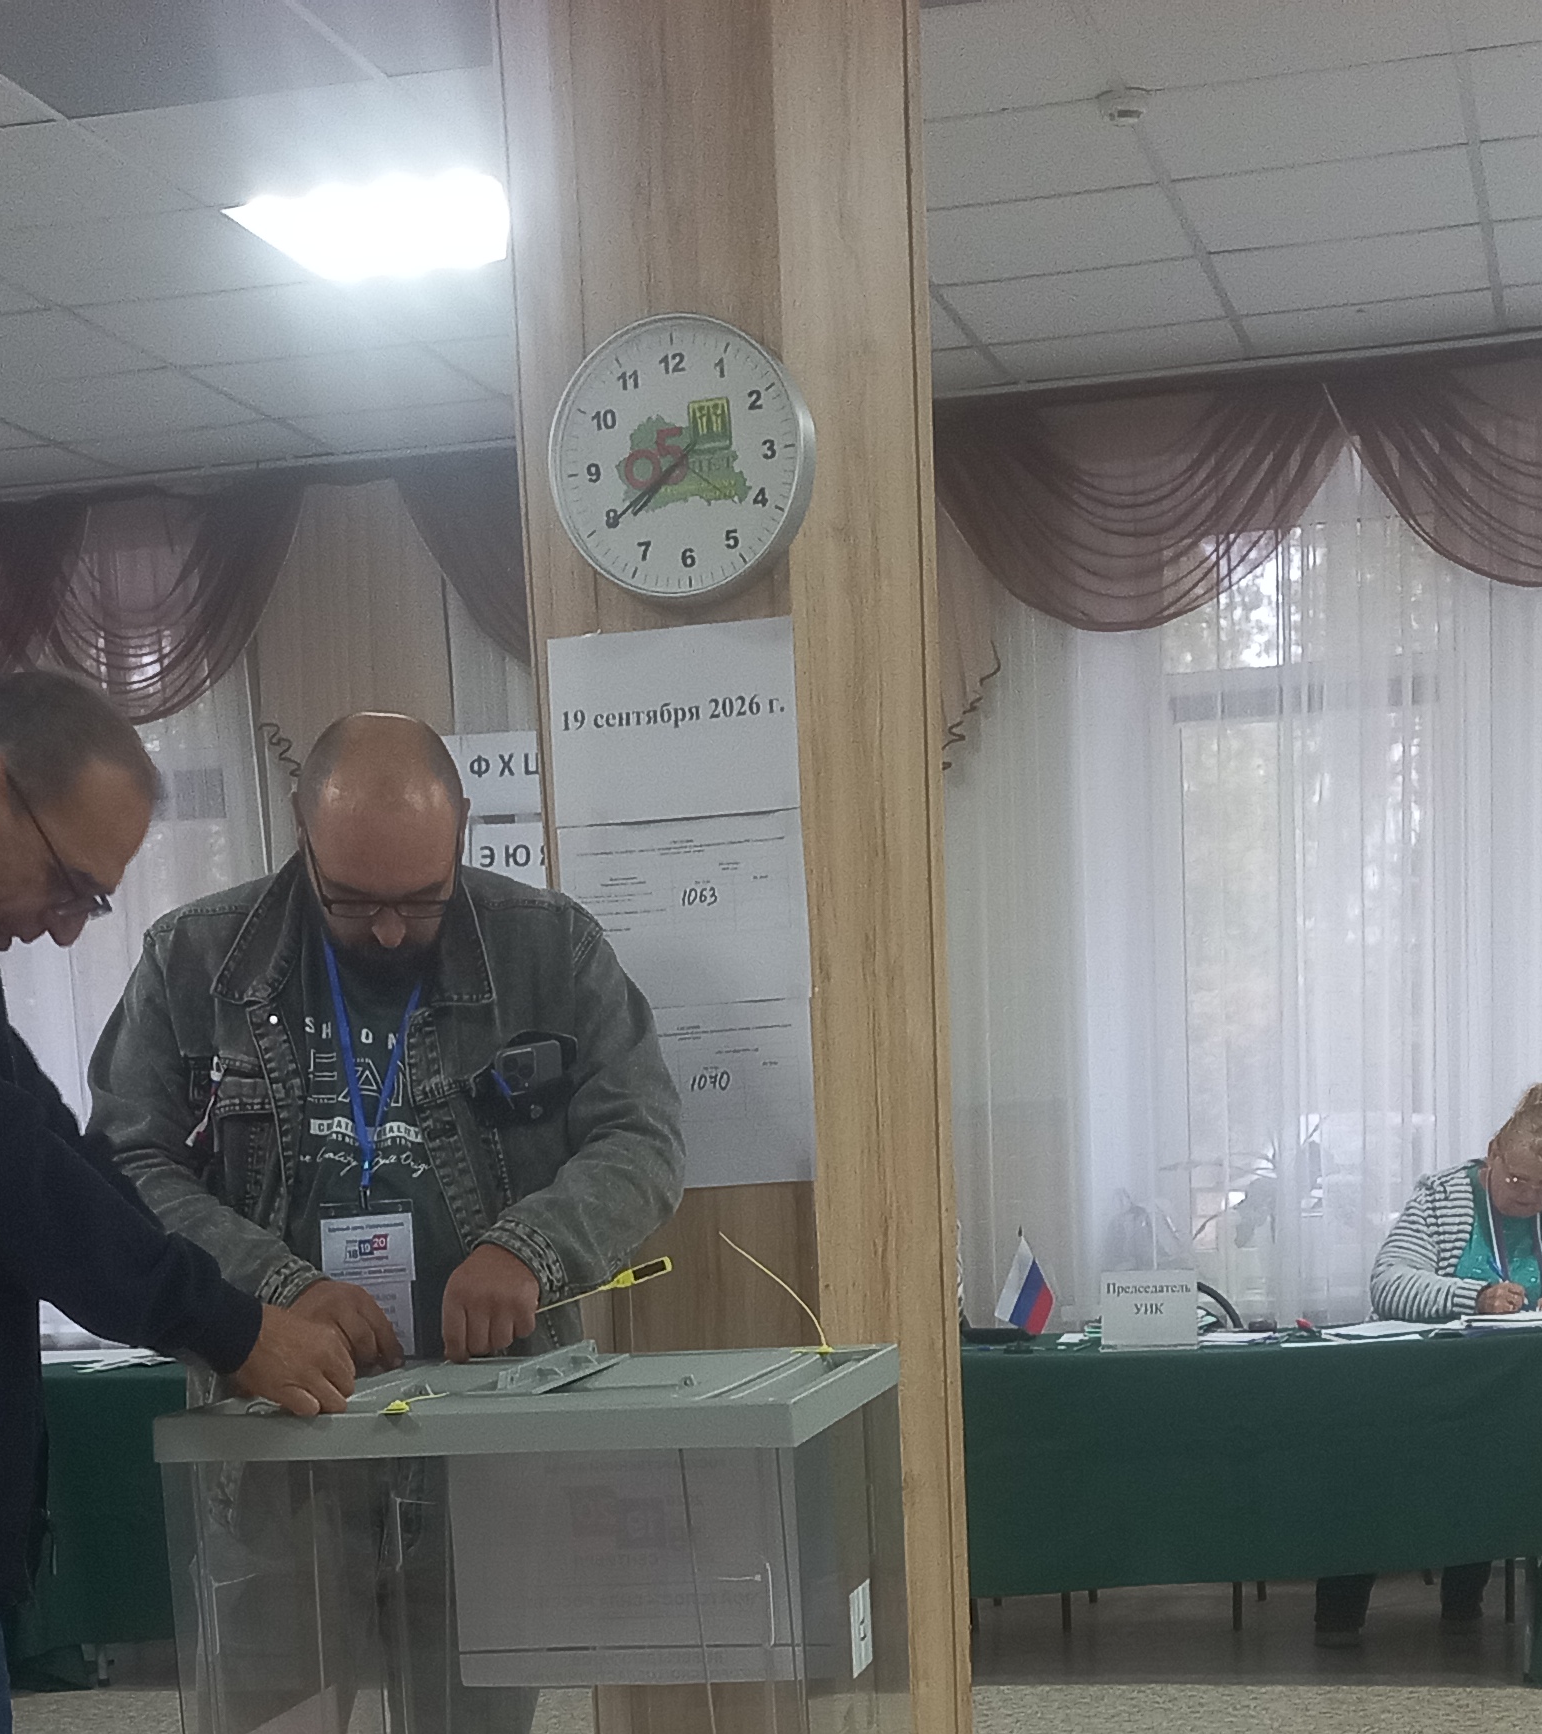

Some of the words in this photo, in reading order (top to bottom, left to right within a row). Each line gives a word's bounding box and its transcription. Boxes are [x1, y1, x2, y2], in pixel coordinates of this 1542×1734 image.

[659, 352, 686, 375] 12
[714, 357, 726, 378] 1
[617, 370, 639, 391] 11
[747, 389, 763, 410] 2
[591, 409, 617, 430] 10
[761, 439, 777, 459] 3
[586, 463, 601, 483] 9
[752, 487, 768, 507] 4
[605, 509, 620, 529] 8
[725, 529, 739, 549] 5
[637, 541, 651, 561] 7
[681, 548, 696, 568] 6
[562, 709, 586, 731] 19
[593, 702, 700, 729] сентября
[708, 694, 761, 720] 2026
[769, 697, 785, 714] г.
[681, 886, 718, 908] 1063
[360, 1243, 371, 1253] 19
[373, 1237, 386, 1248] 20
[347, 1249, 359, 1259] 18
[1106, 1282, 1191, 1296] Председатель
[1133, 1303, 1164, 1315] УИК
